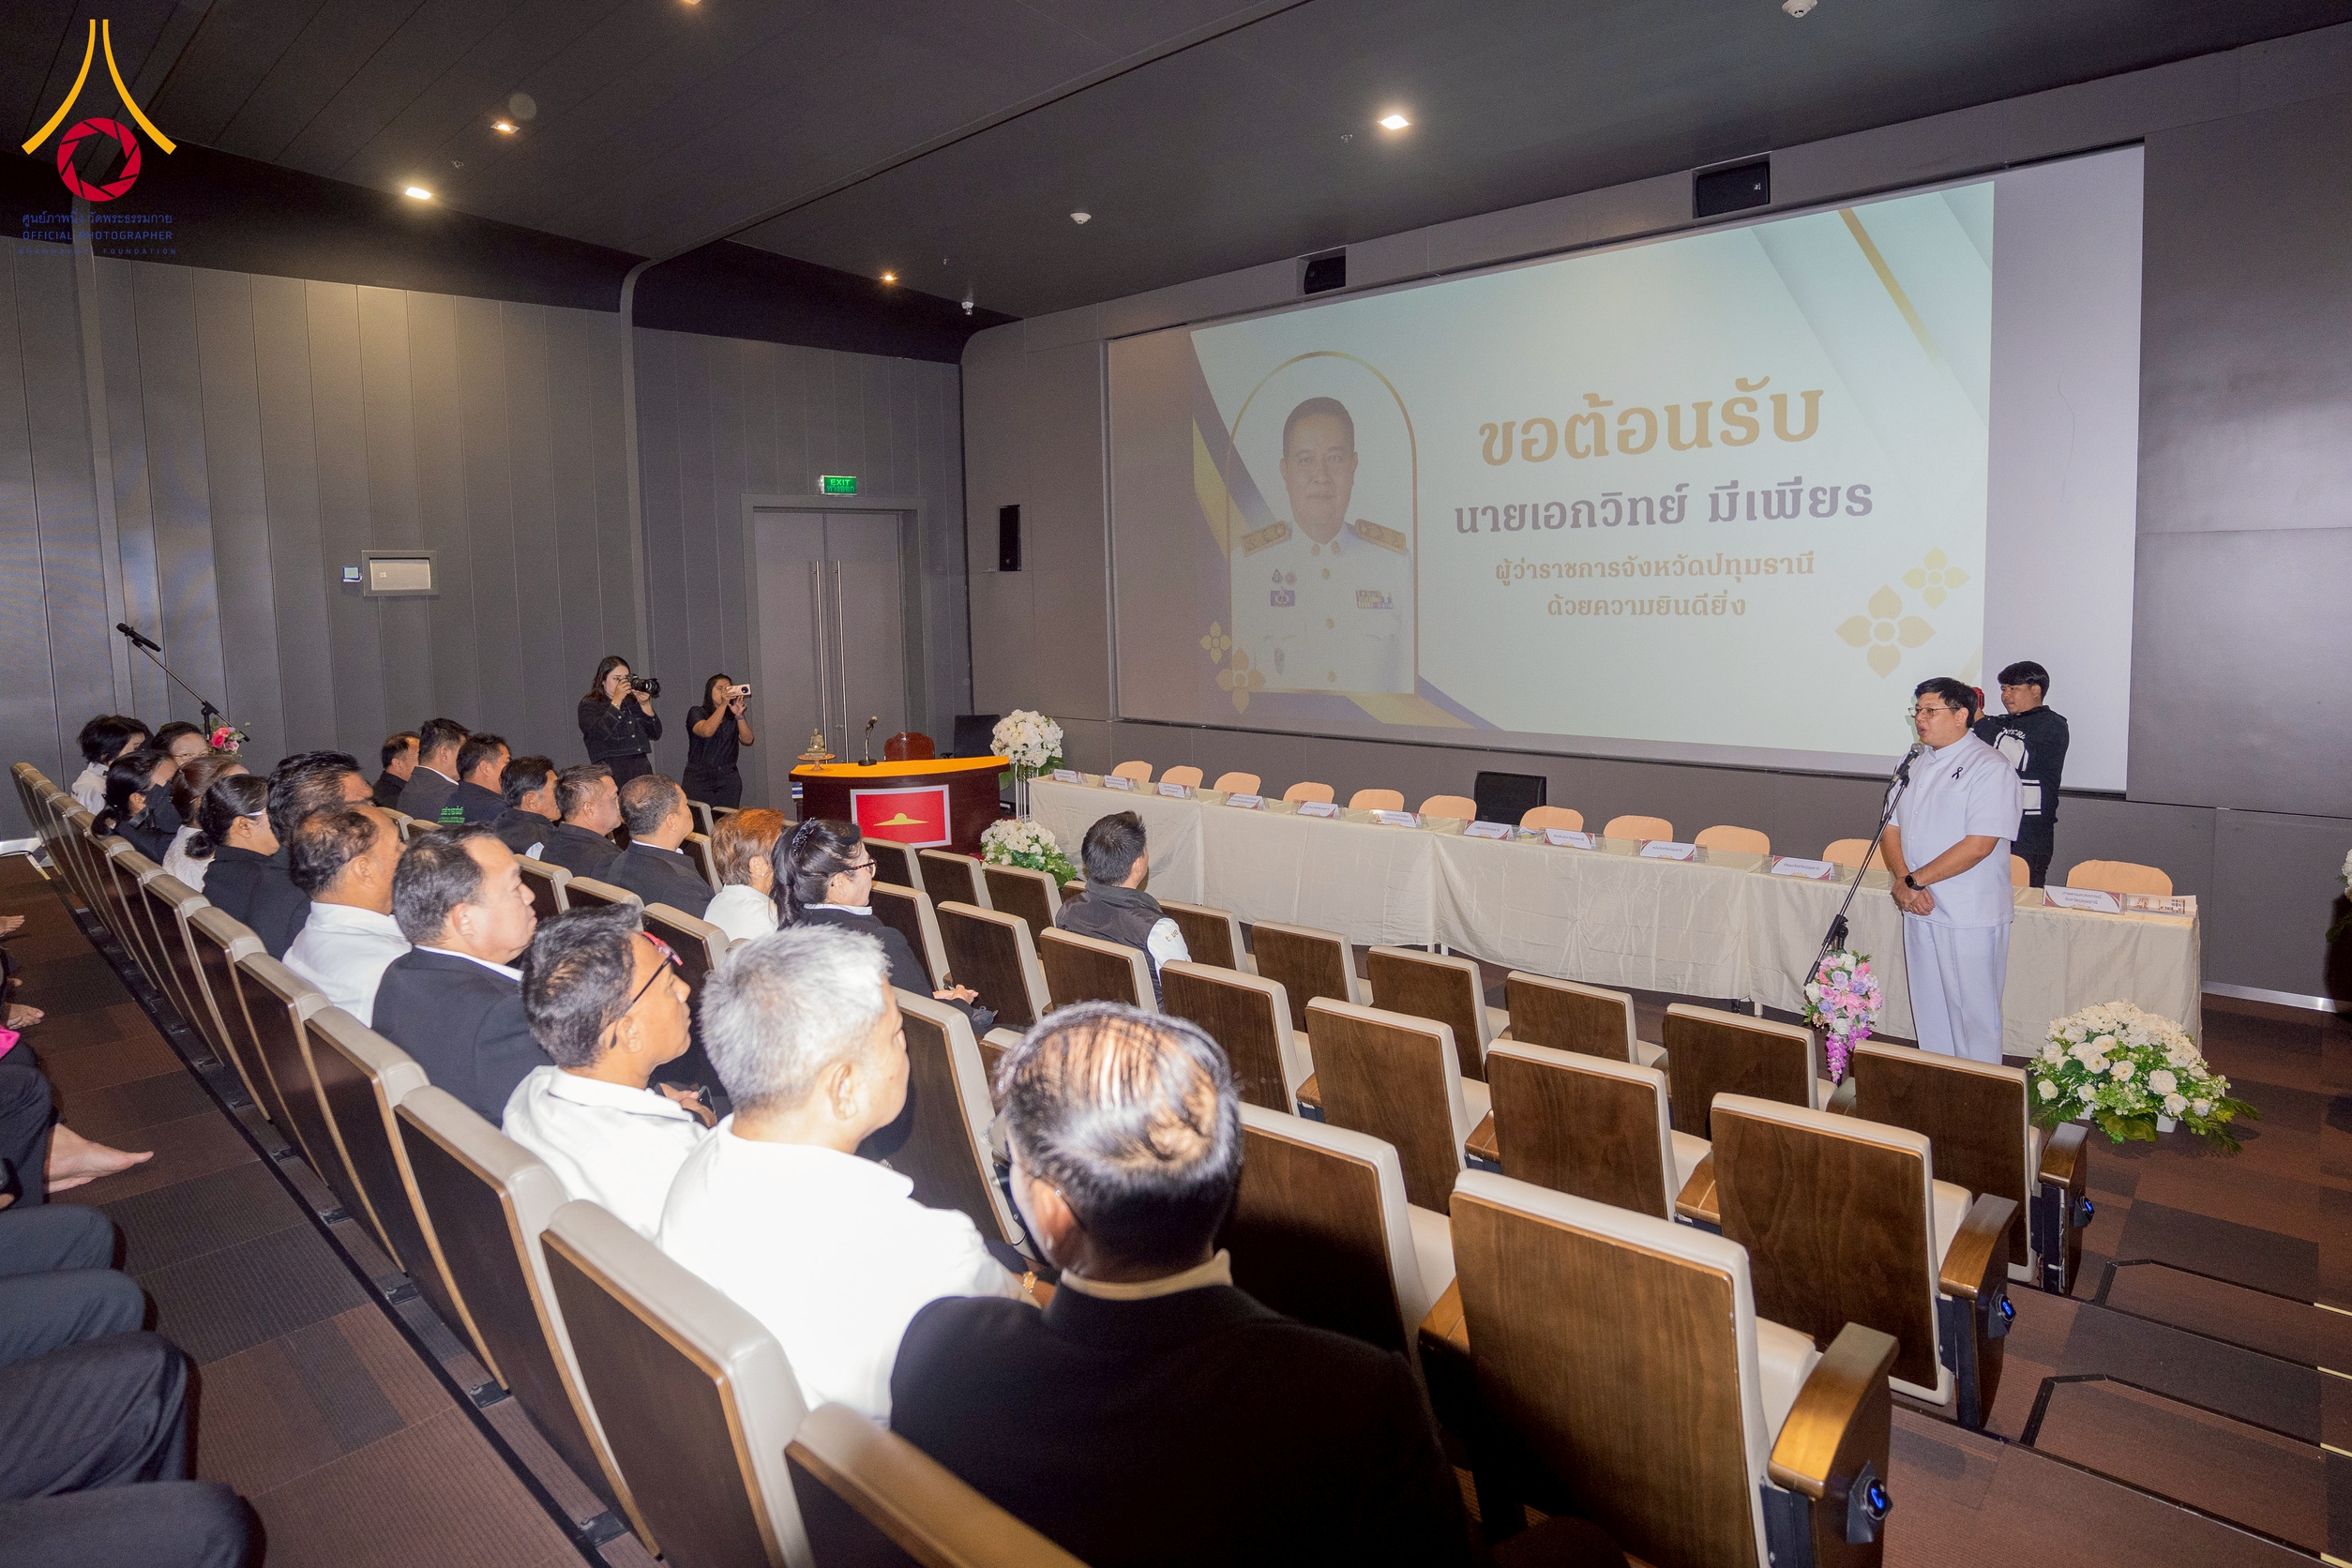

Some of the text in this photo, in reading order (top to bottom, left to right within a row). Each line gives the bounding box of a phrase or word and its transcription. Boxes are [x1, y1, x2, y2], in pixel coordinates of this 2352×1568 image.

[1478, 375, 1825, 467] ขอต้อนรับ
[1455, 475, 1874, 535] นายเอกวิทย์ มีเพียร
[1495, 550, 1815, 587] ผู้ว่าราชการจังหวัดปทุมธานี
[1547, 590, 1747, 616] ด้วยความยินดียิ่ง
[1871, 1486, 1885, 1510] C
